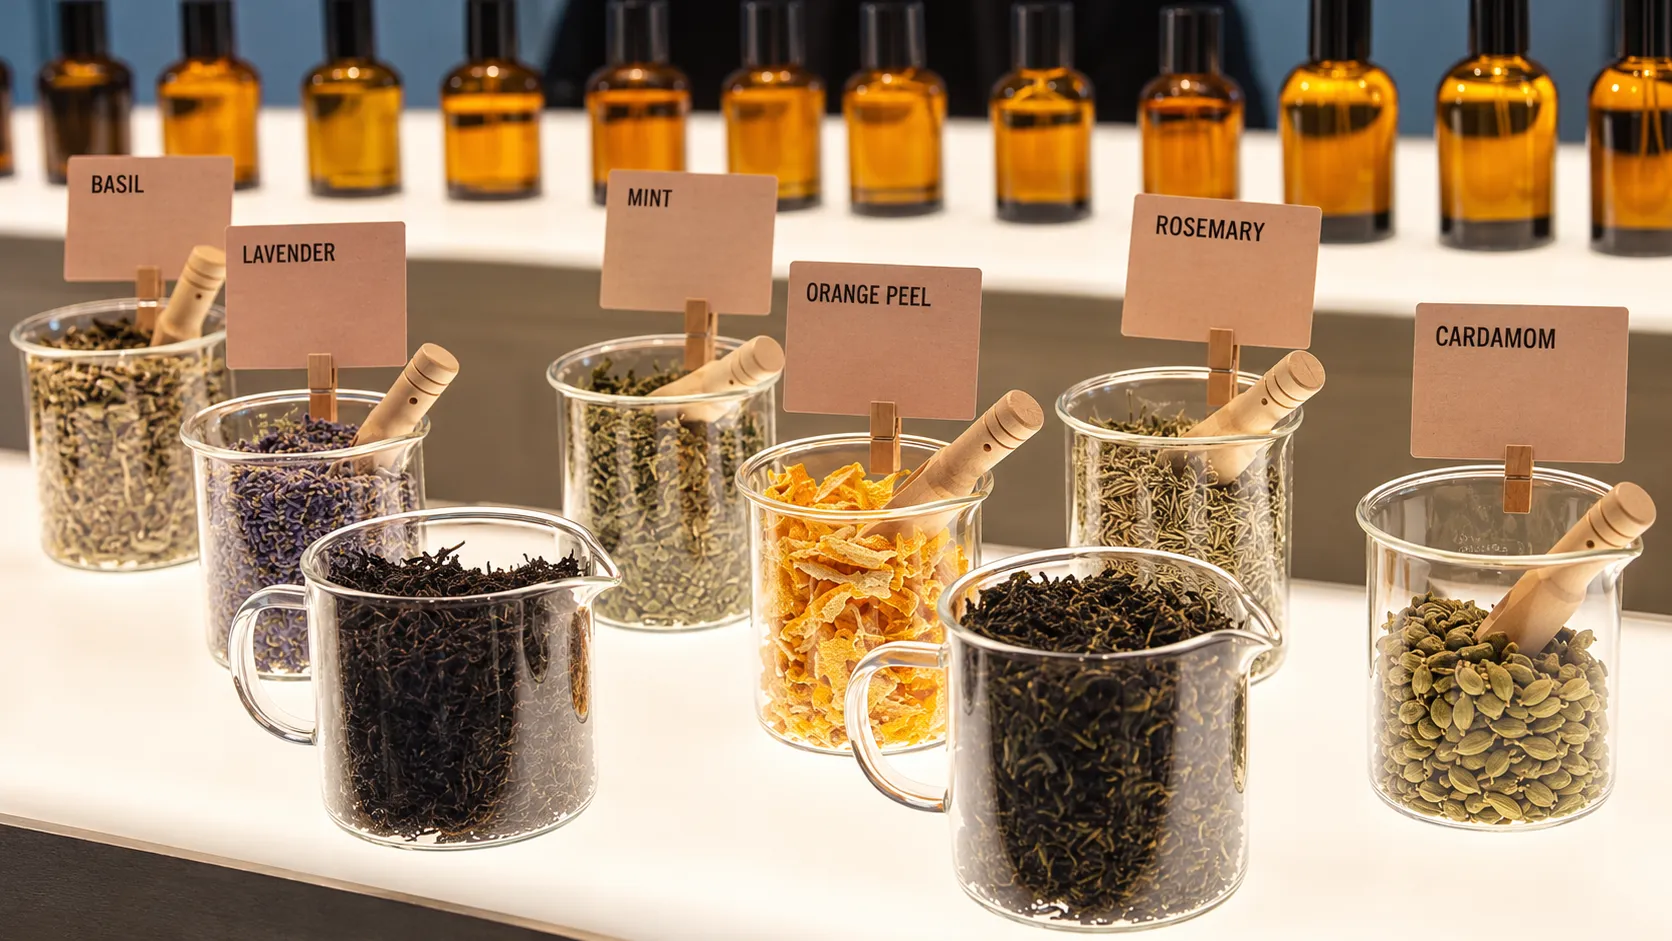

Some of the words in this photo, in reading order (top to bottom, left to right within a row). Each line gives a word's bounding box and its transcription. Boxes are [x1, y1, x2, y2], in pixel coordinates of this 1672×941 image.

[91, 175, 145, 194] BASIL
[627, 188, 673, 208] MINT
[1155, 214, 1266, 242] ROSEMARY
[242, 243, 336, 265] LAVENDER
[806, 282, 880, 305] ORANGE
[886, 285, 932, 307] PEEL
[1435, 325, 1556, 350] CARDAMOM
